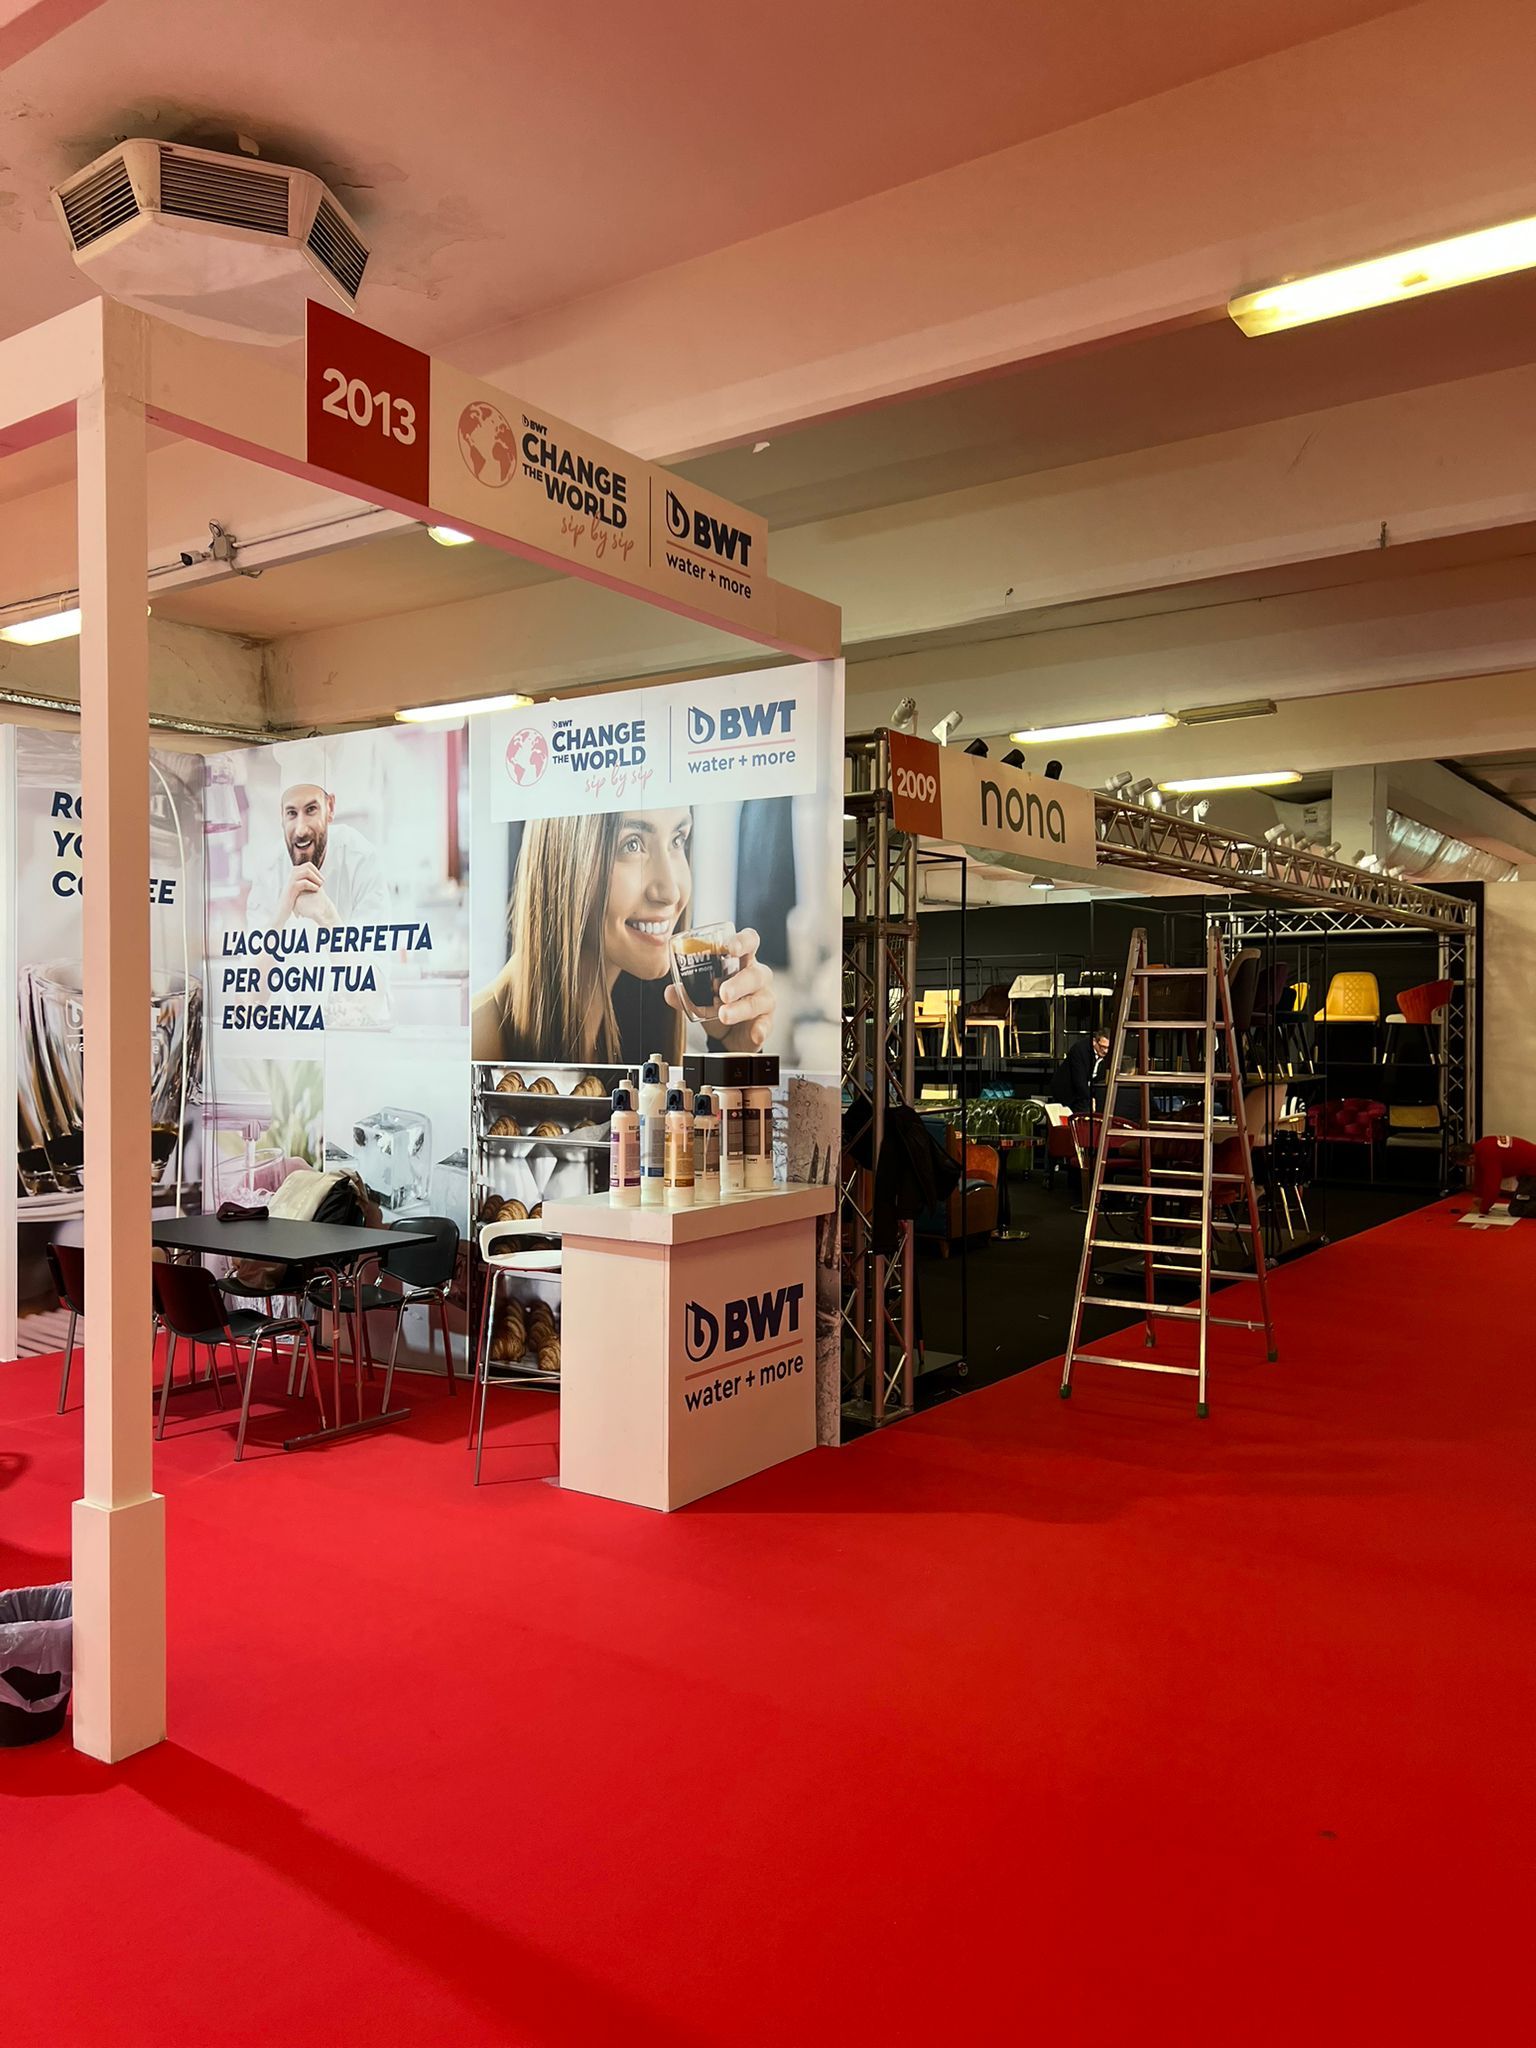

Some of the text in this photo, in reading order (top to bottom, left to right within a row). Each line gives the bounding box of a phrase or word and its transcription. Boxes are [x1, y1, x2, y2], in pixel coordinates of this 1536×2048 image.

[322, 367, 417, 446] 2013
[529, 420, 548, 436] BWT
[522, 432, 627, 504] CHANGE
[522, 462, 628, 530] THE WORLD
[560, 511, 634, 562] sip by sip
[693, 509, 752, 568] BWT
[665, 551, 752, 599] water + more
[552, 720, 646, 753] CHANGE
[558, 719, 573, 728] BWT
[720, 699, 796, 741] BWT
[552, 745, 646, 773] THE WORLD
[687, 750, 796, 774] water + more
[584, 764, 654, 798] sip by sip
[896, 767, 937, 804] 2009
[980, 779, 1066, 844] nona
[222, 922, 433, 962] L'ACQUA PERFETTA
[222, 964, 377, 993] PER OGNI TUA
[222, 1003, 325, 1031] ESIGENZA
[724, 1282, 804, 1353] BWT
[684, 1354, 804, 1413] water + more
